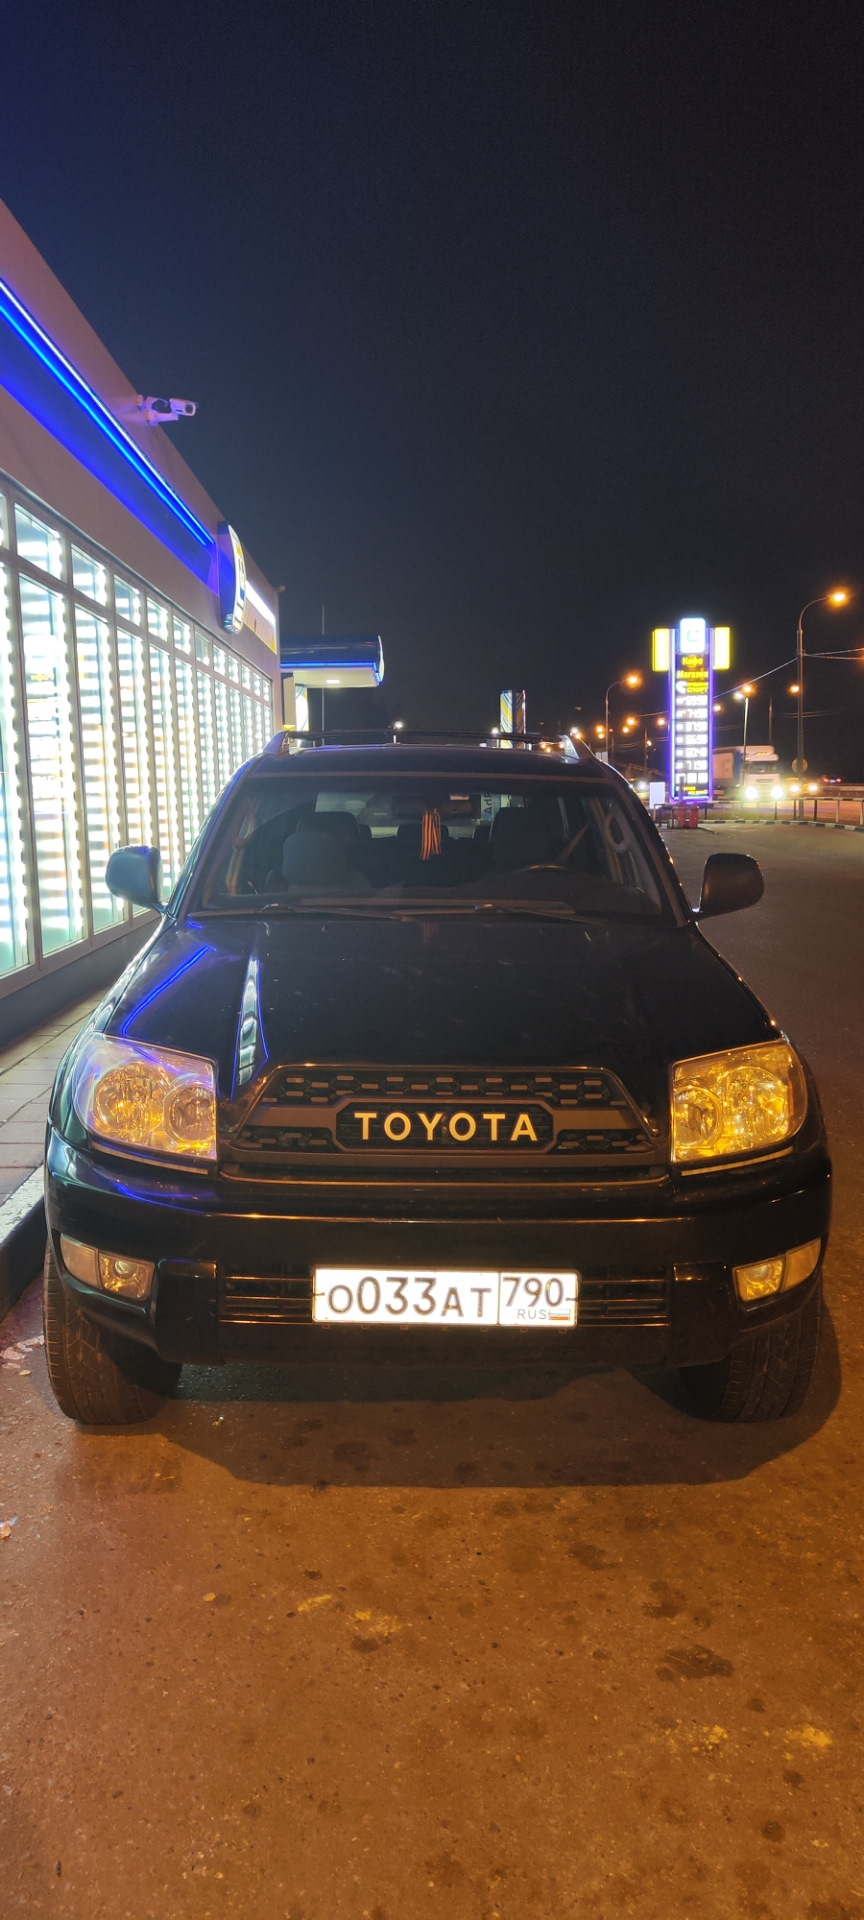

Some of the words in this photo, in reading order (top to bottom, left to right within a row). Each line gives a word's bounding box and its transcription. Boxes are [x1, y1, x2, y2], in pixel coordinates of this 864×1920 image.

[682, 657, 703, 667] Кафе
[677, 670, 709, 679] Магазин
[354, 1112, 538, 1142] TOYOTA
[503, 1277, 564, 1308] 790
[517, 1309, 547, 1320] RUS
